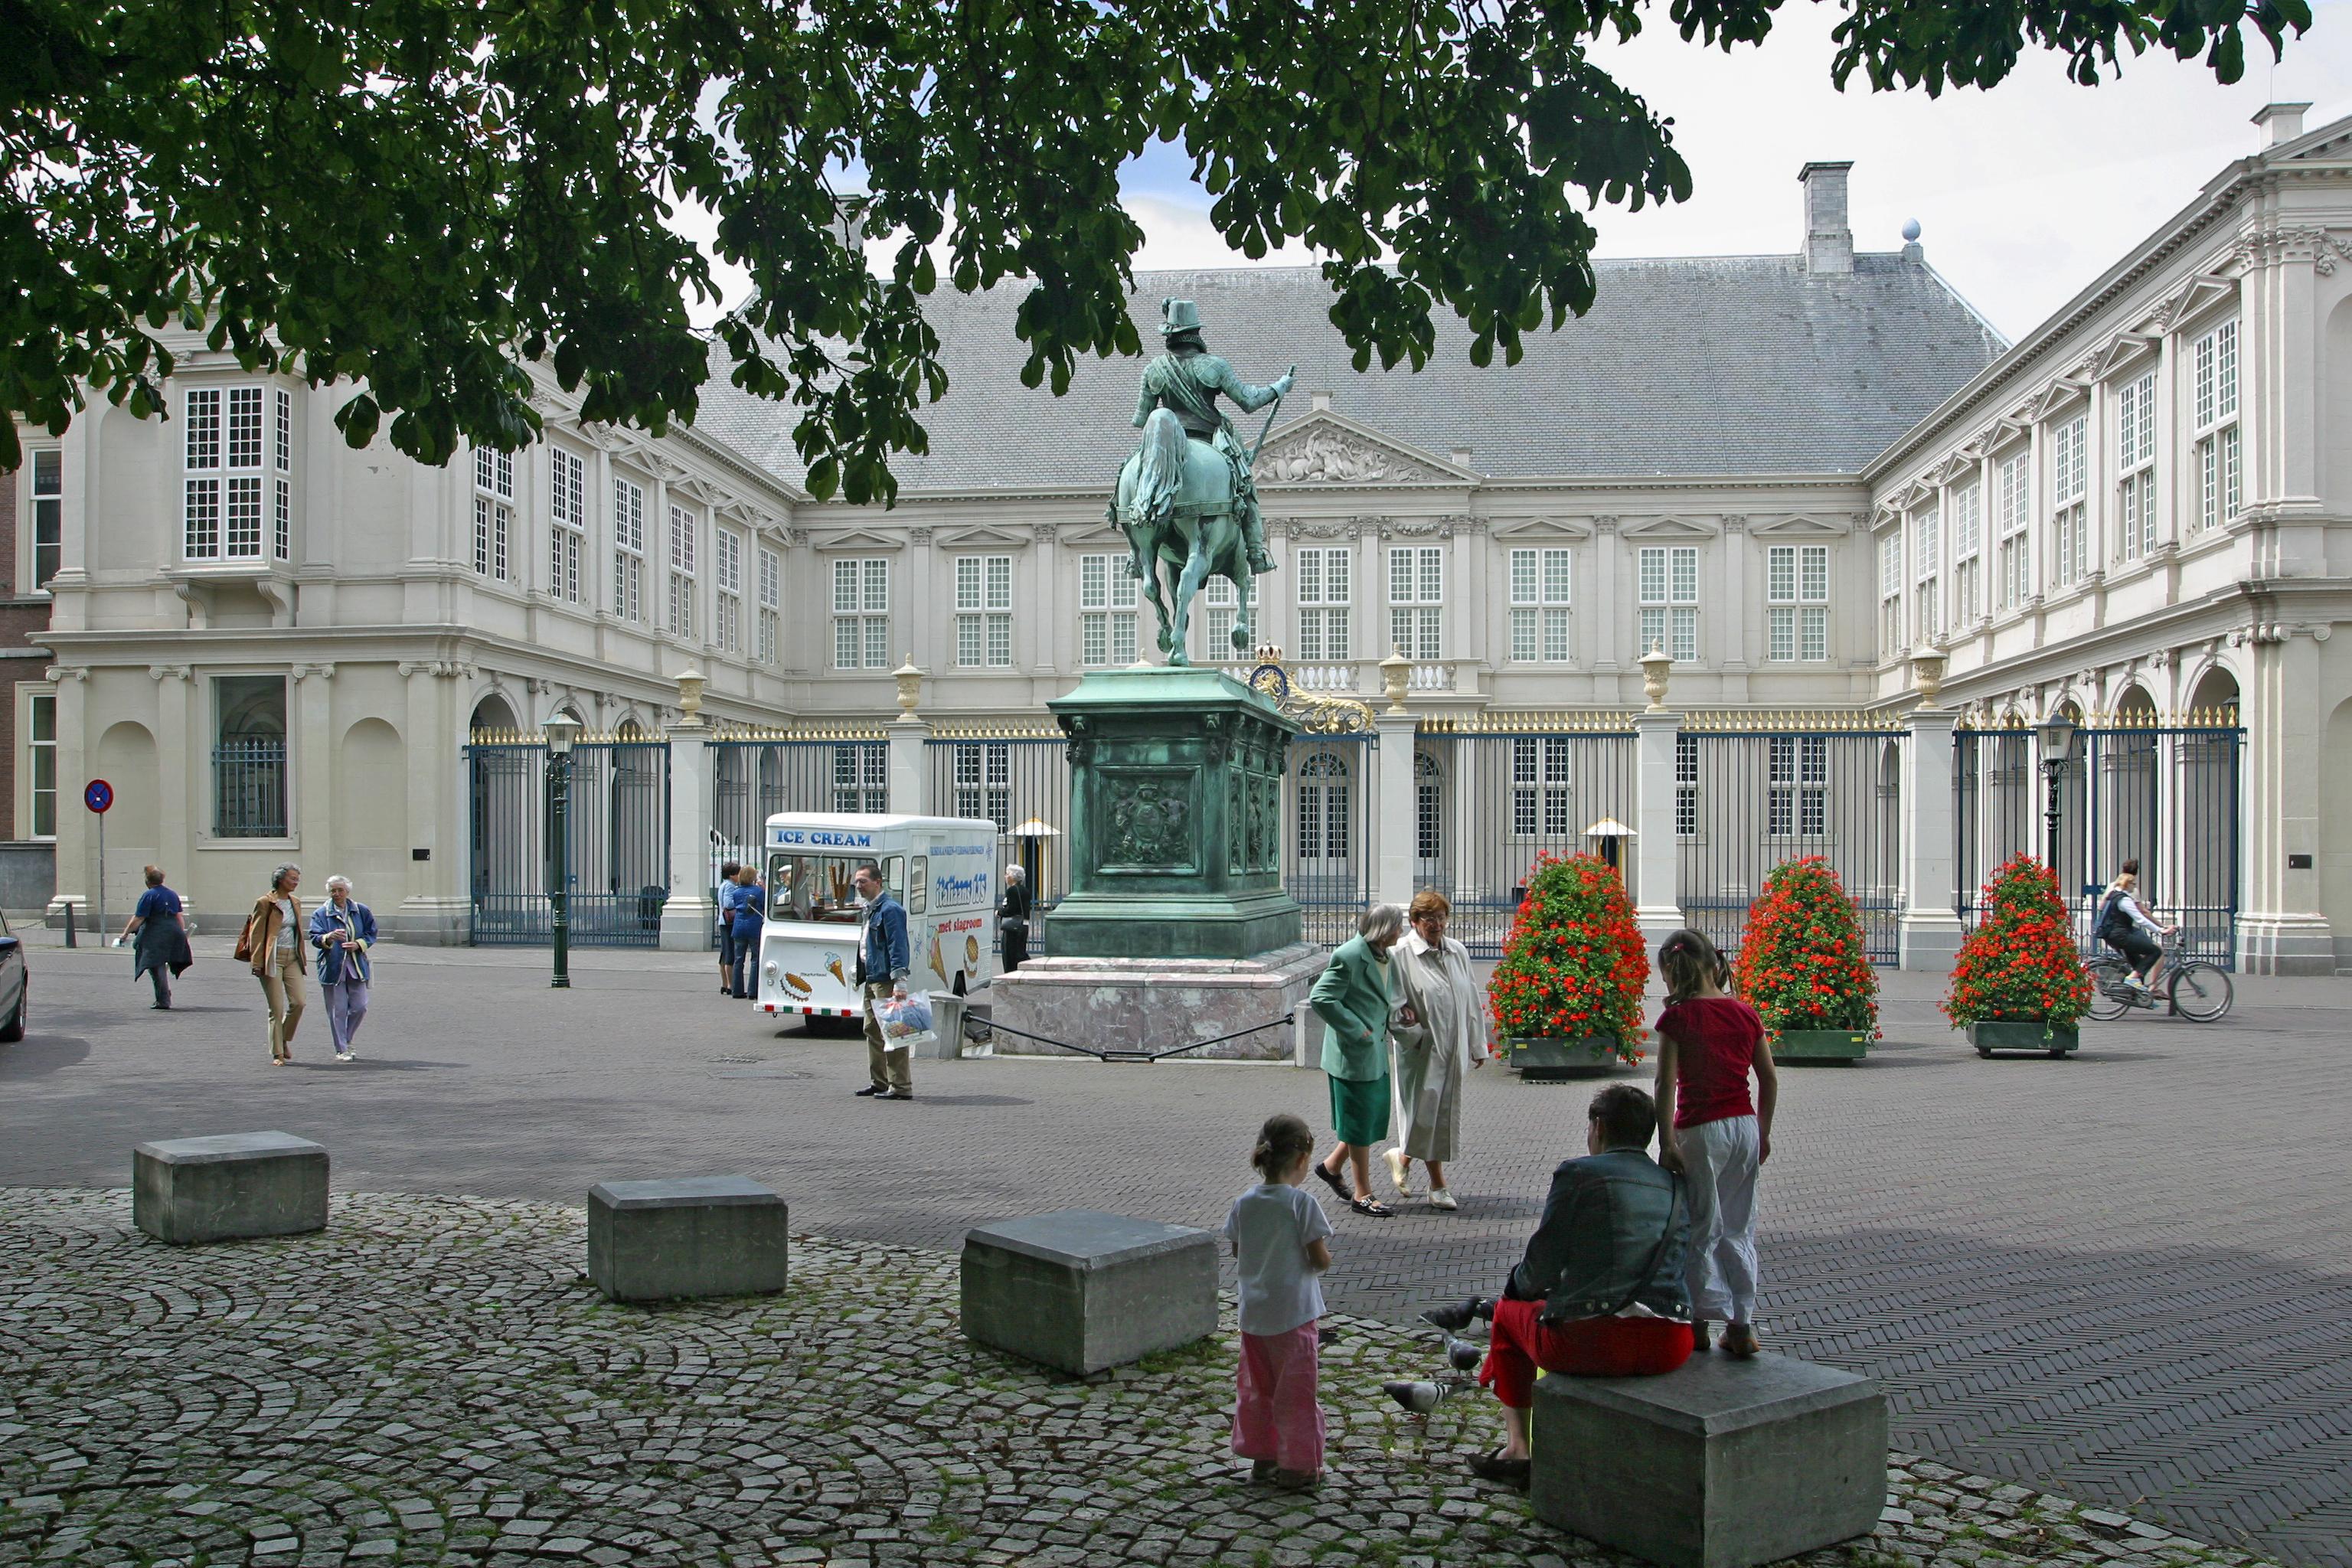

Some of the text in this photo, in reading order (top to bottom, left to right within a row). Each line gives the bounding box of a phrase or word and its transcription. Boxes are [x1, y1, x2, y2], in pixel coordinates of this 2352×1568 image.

[777, 831, 871, 847] ICE CREAM
[939, 918, 982, 933] met slagroom
